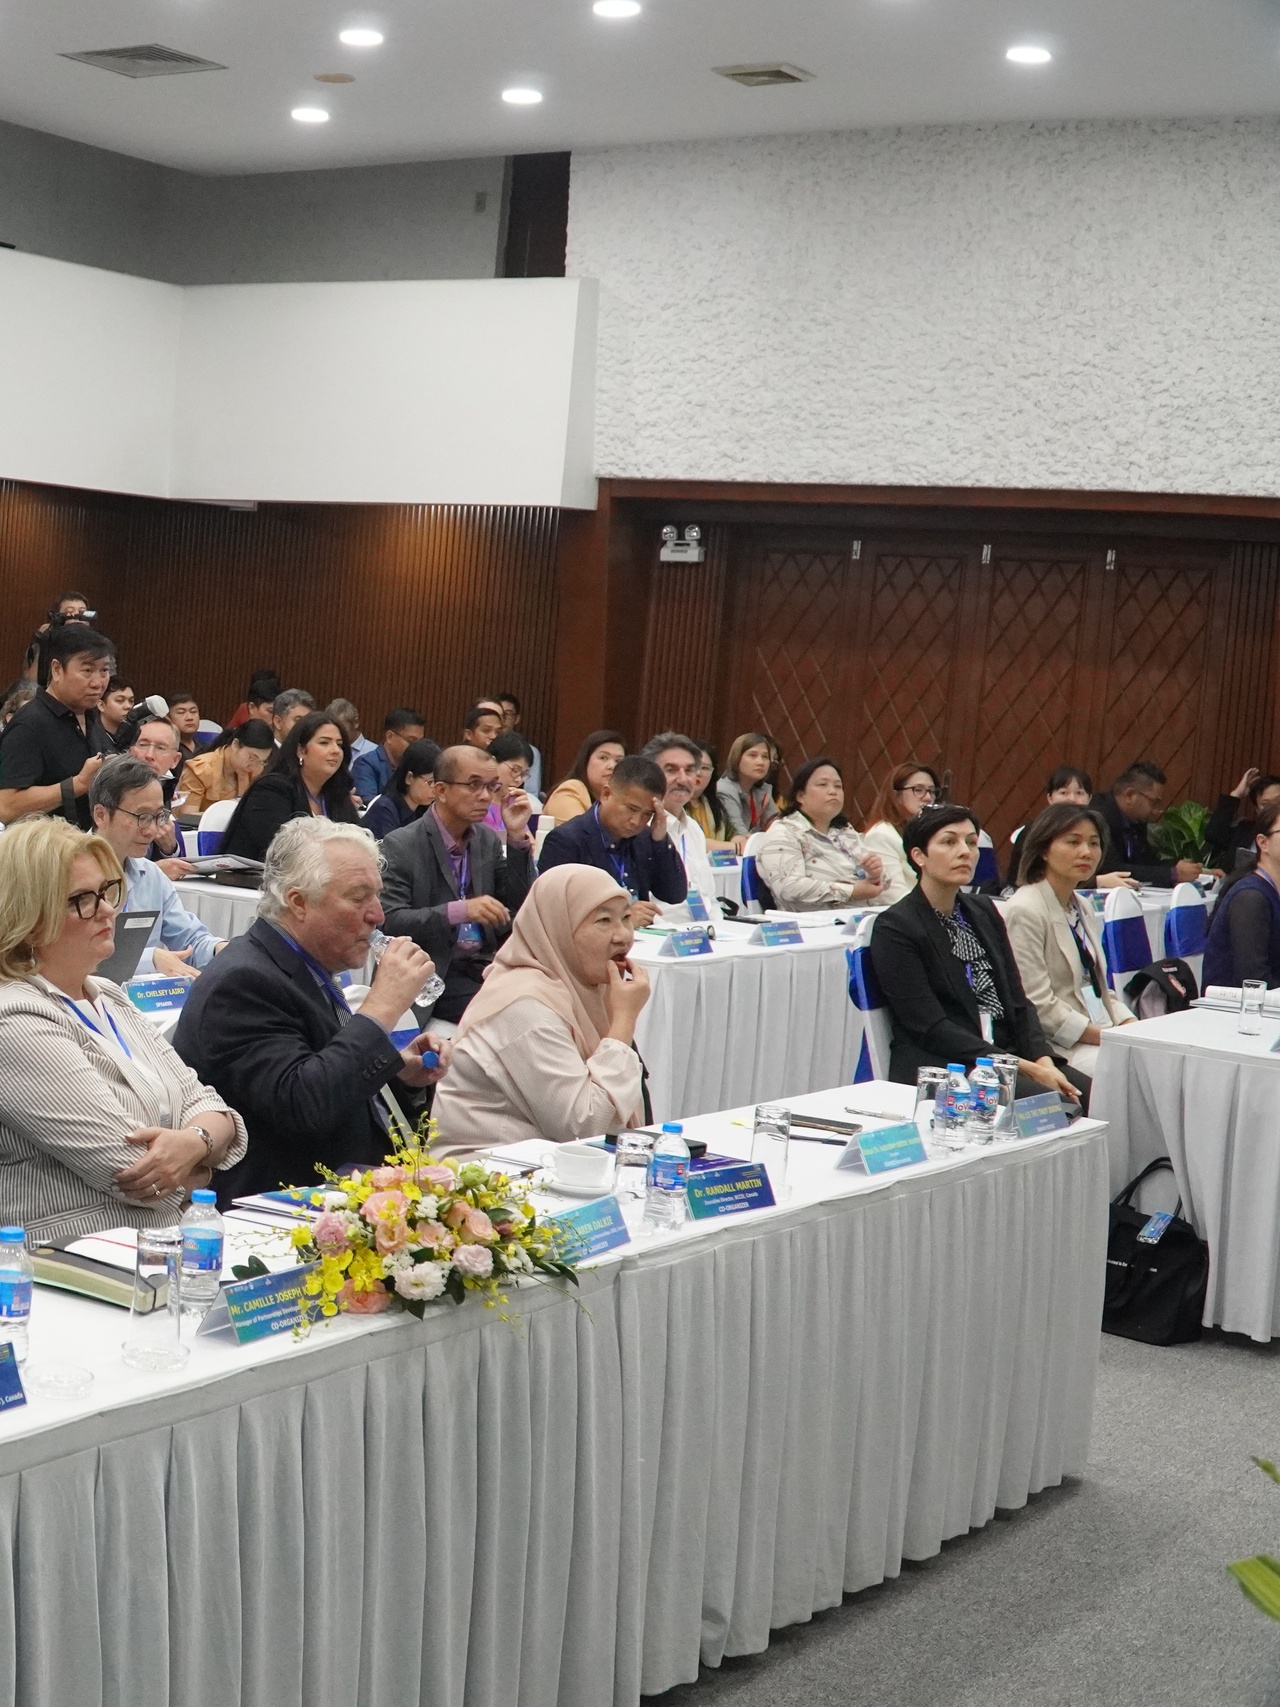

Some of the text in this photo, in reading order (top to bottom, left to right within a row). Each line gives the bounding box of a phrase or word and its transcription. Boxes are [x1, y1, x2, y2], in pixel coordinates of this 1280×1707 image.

[146, 989, 168, 997] CHELSEY
[694, 1179, 762, 1198] Dr. RANDALL MARTIN
[230, 1305, 243, 1316] Mr.
[244, 1294, 275, 1312] CAMILLE
[276, 1288, 303, 1304] JOSEPH
[5, 1392, 23, 1403] Canada
